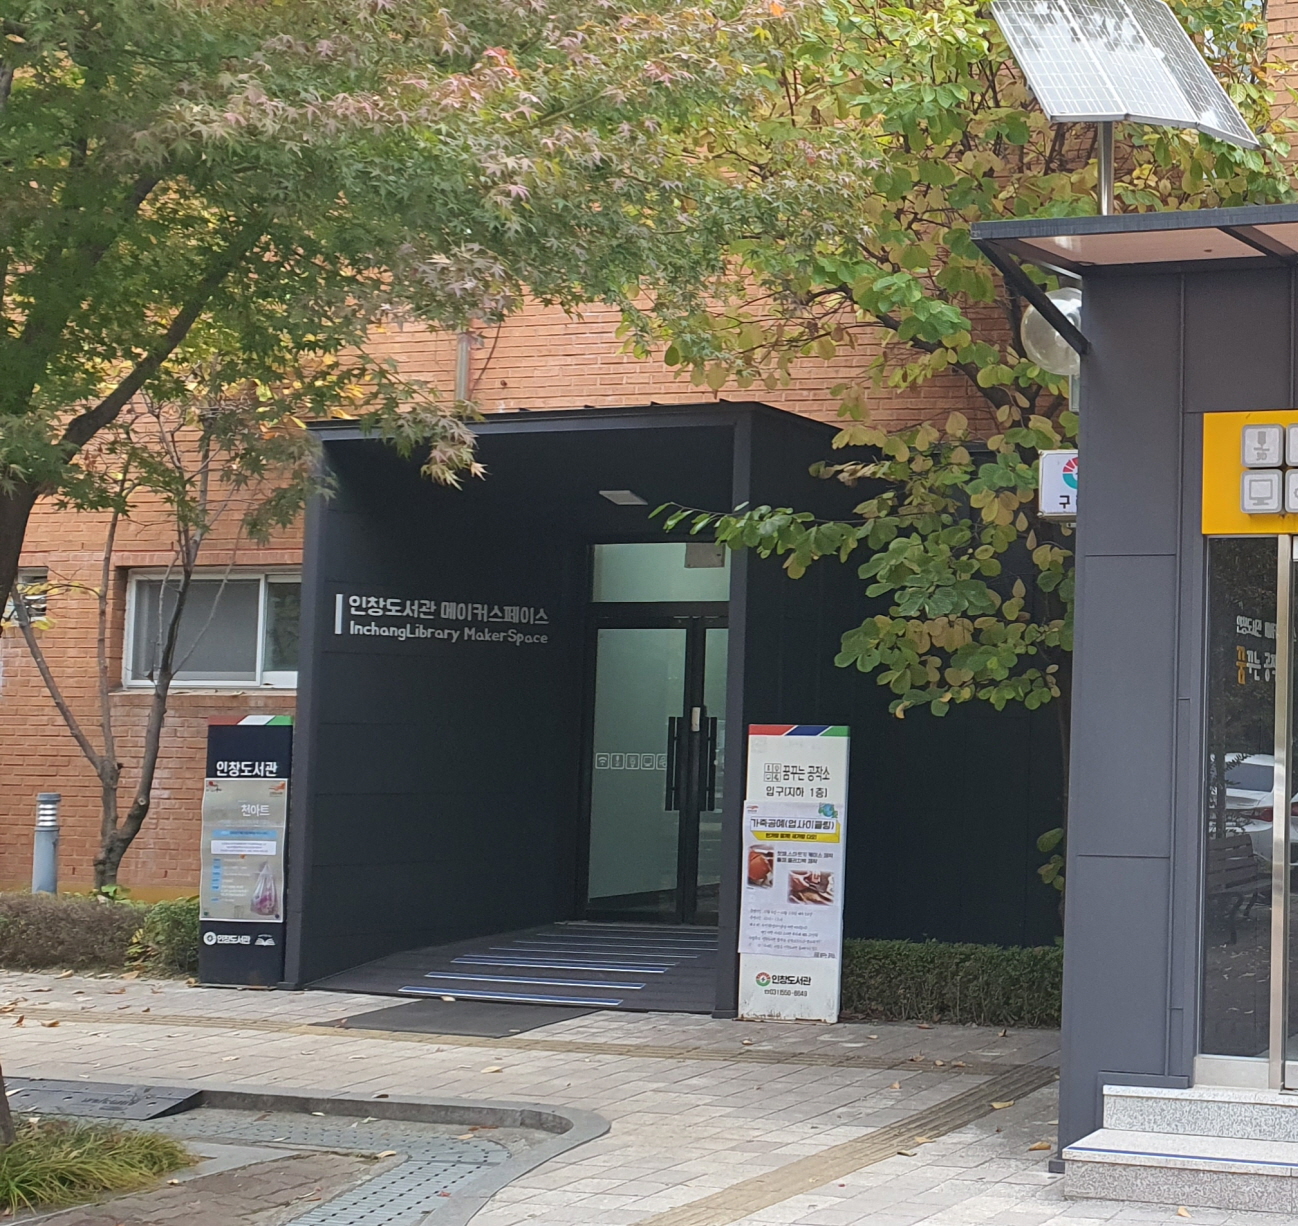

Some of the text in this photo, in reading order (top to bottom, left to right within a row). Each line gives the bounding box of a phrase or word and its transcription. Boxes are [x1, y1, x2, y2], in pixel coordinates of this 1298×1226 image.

[348, 594, 550, 625] 인창도서관 메이커스페이스
[349, 620, 549, 647] InchangLibrary MakerSpace
[216, 761, 277, 777] 인창도서관
[782, 765, 830, 782] 꿈꾸는 공작소
[241, 803, 271, 817] 천아트
[217, 933, 251, 945] 인창도서관
[771, 974, 812, 986] 인창도서관
